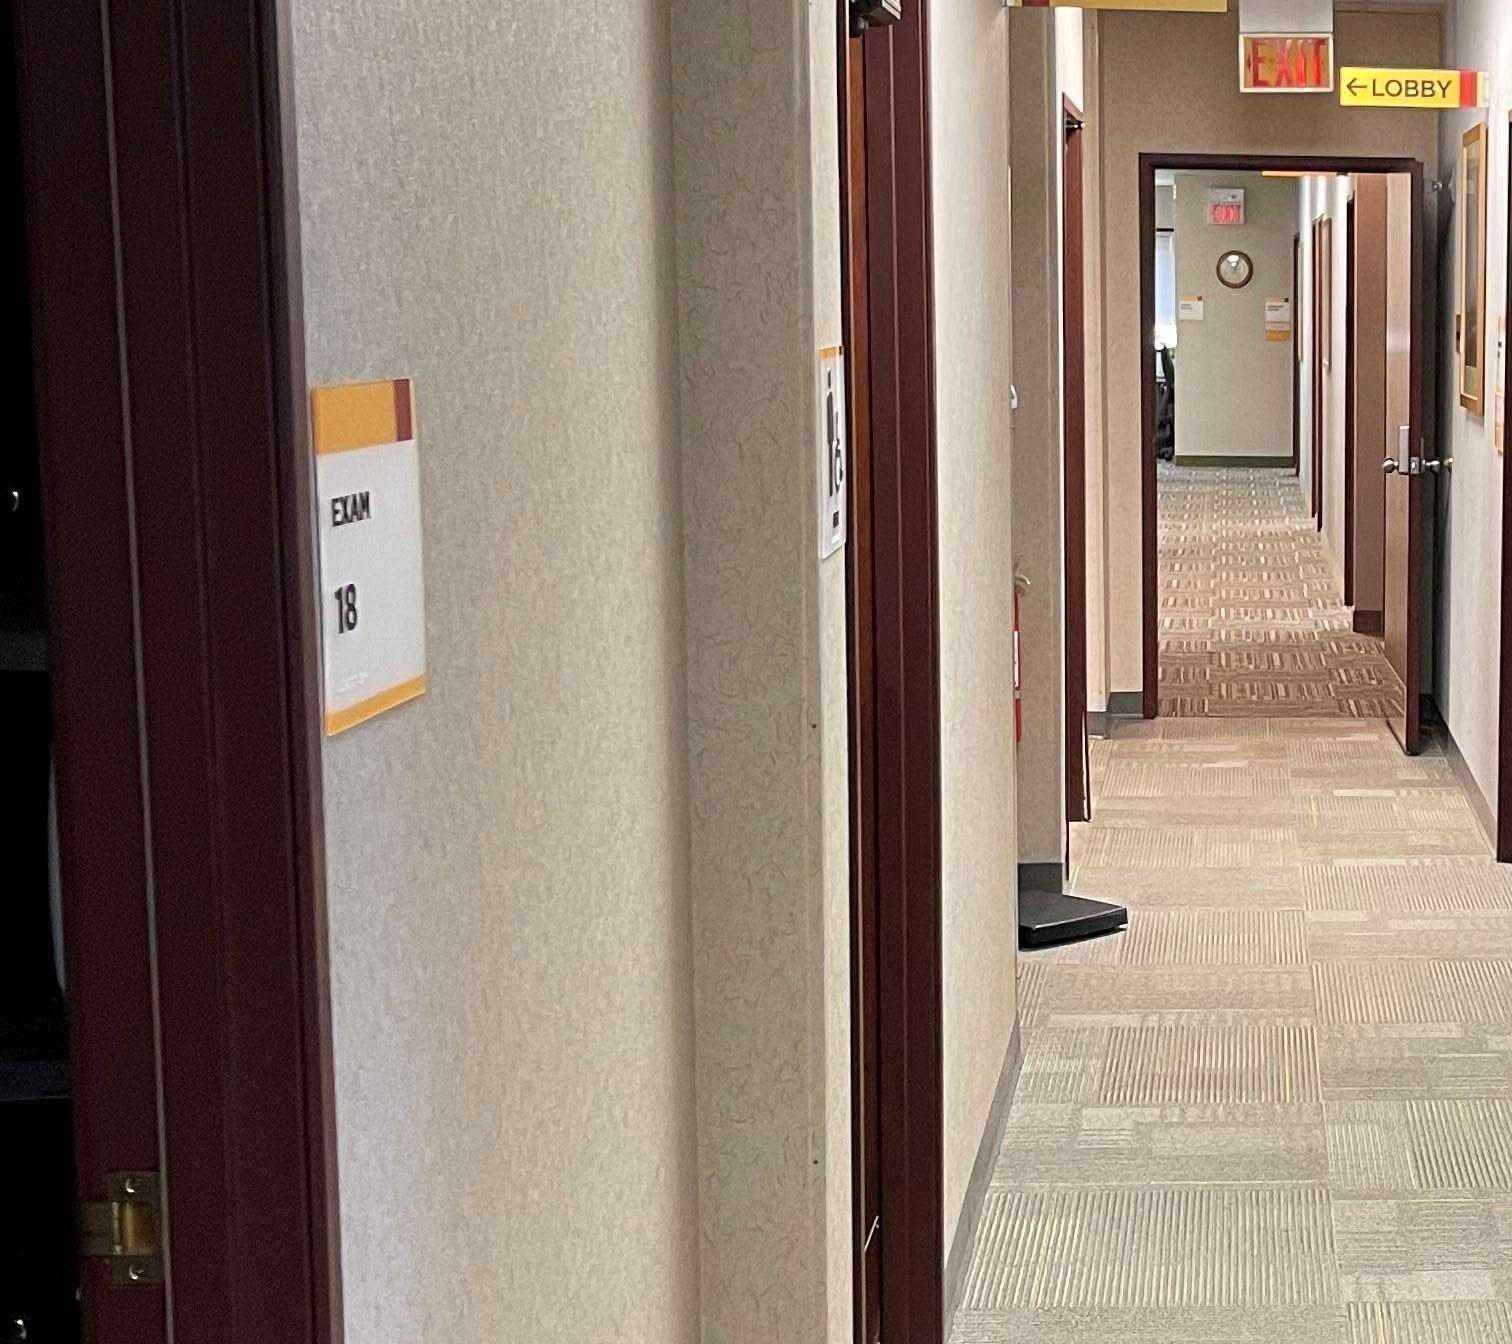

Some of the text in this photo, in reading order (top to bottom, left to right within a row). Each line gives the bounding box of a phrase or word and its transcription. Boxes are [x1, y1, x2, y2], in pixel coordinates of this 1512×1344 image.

[1252, 38, 1326, 86] EXIT
[1372, 78, 1452, 98] LOBBY
[331, 490, 372, 527] EXAM
[334, 583, 358, 634] 18
